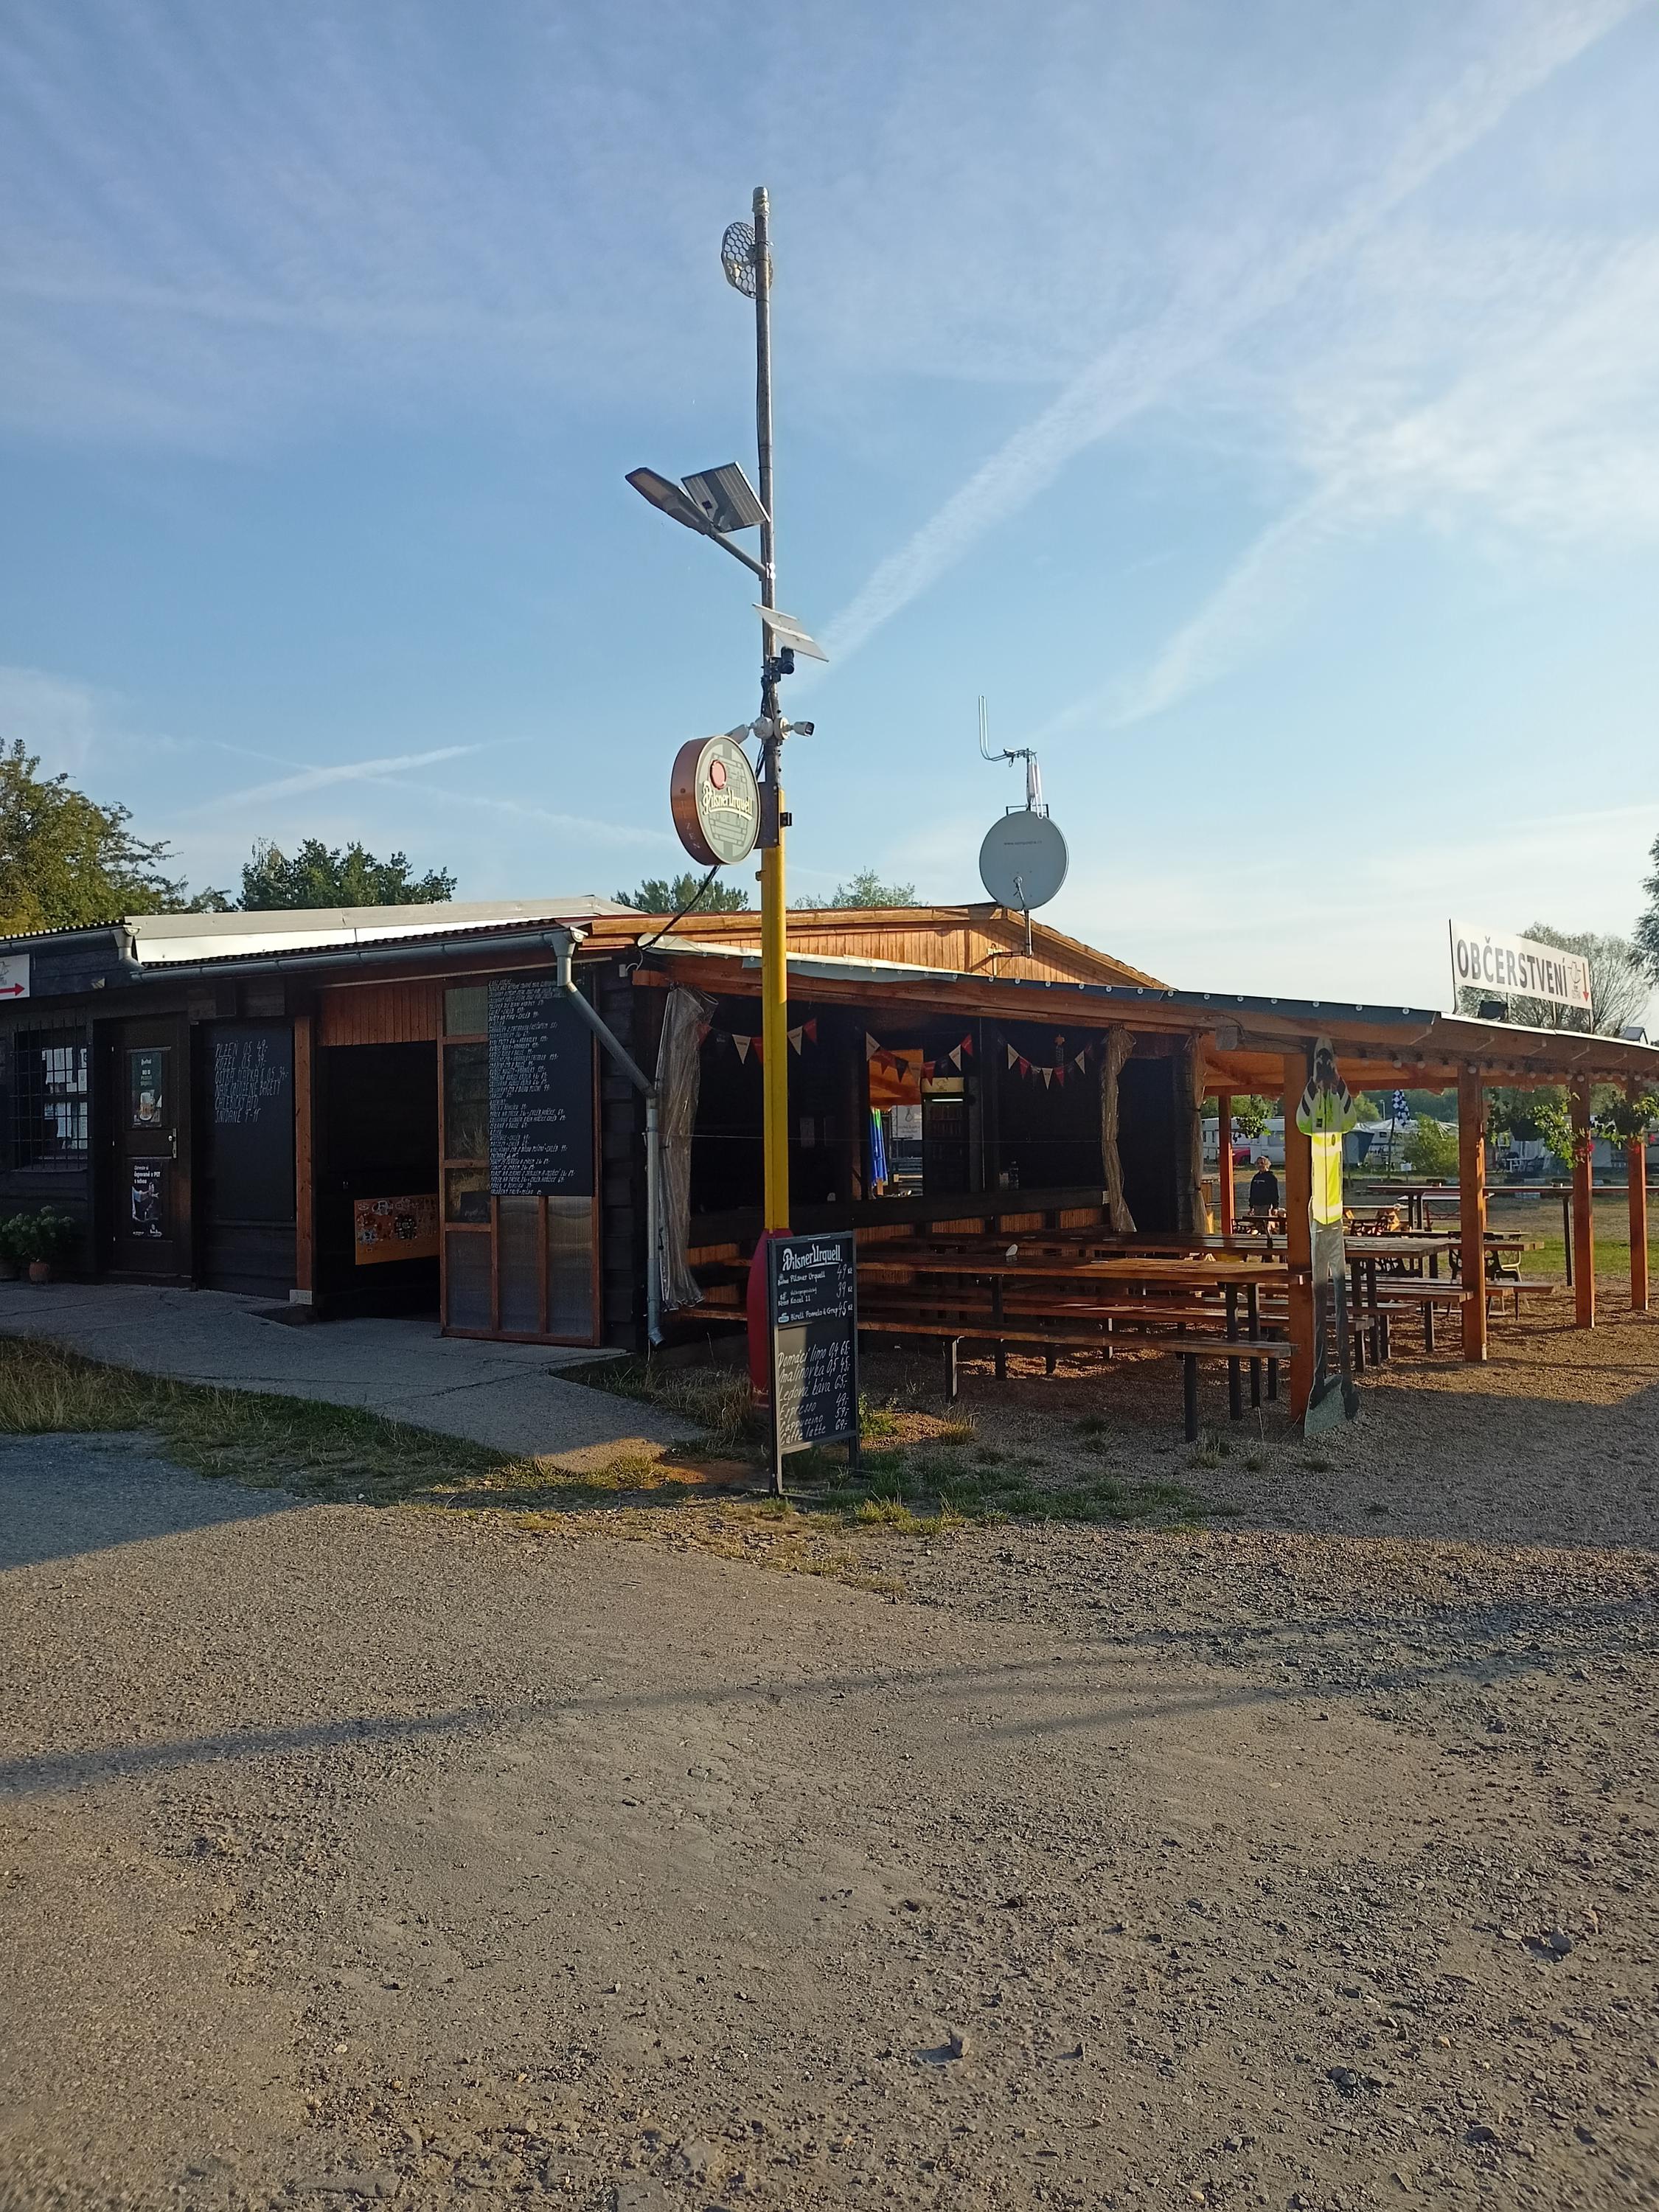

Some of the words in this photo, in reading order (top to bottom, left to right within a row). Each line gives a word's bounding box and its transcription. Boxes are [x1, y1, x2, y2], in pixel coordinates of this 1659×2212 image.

[702, 780, 730, 815] Pilsner
[728, 787, 753, 816] Urquell
[1457, 936, 1568, 998] OBČERSTVENÍ
[782, 1248, 814, 1271] Pilsner
[790, 1274, 808, 1283] Pilsner
[808, 1270, 826, 1283] Urquell
[837, 1264, 847, 1280] 49
[790, 1295, 804, 1304] Kozel
[836, 1281, 846, 1298] 39
[790, 1312, 804, 1321] Birell
[805, 1308, 823, 1318] Pomelo
[827, 1307, 838, 1318] Grep
[838, 1301, 848, 1318] 45
[779, 1347, 810, 1368] Domácí
[810, 1343, 827, 1362] limo
[826, 1357, 840, 1377] 0,5
[779, 1380, 810, 1401] Ledová
[812, 1377, 831, 1396] káva
[779, 1401, 817, 1424] Espresso
[779, 1413, 824, 1435] Cappuccino
[805, 1422, 826, 1438] latte
